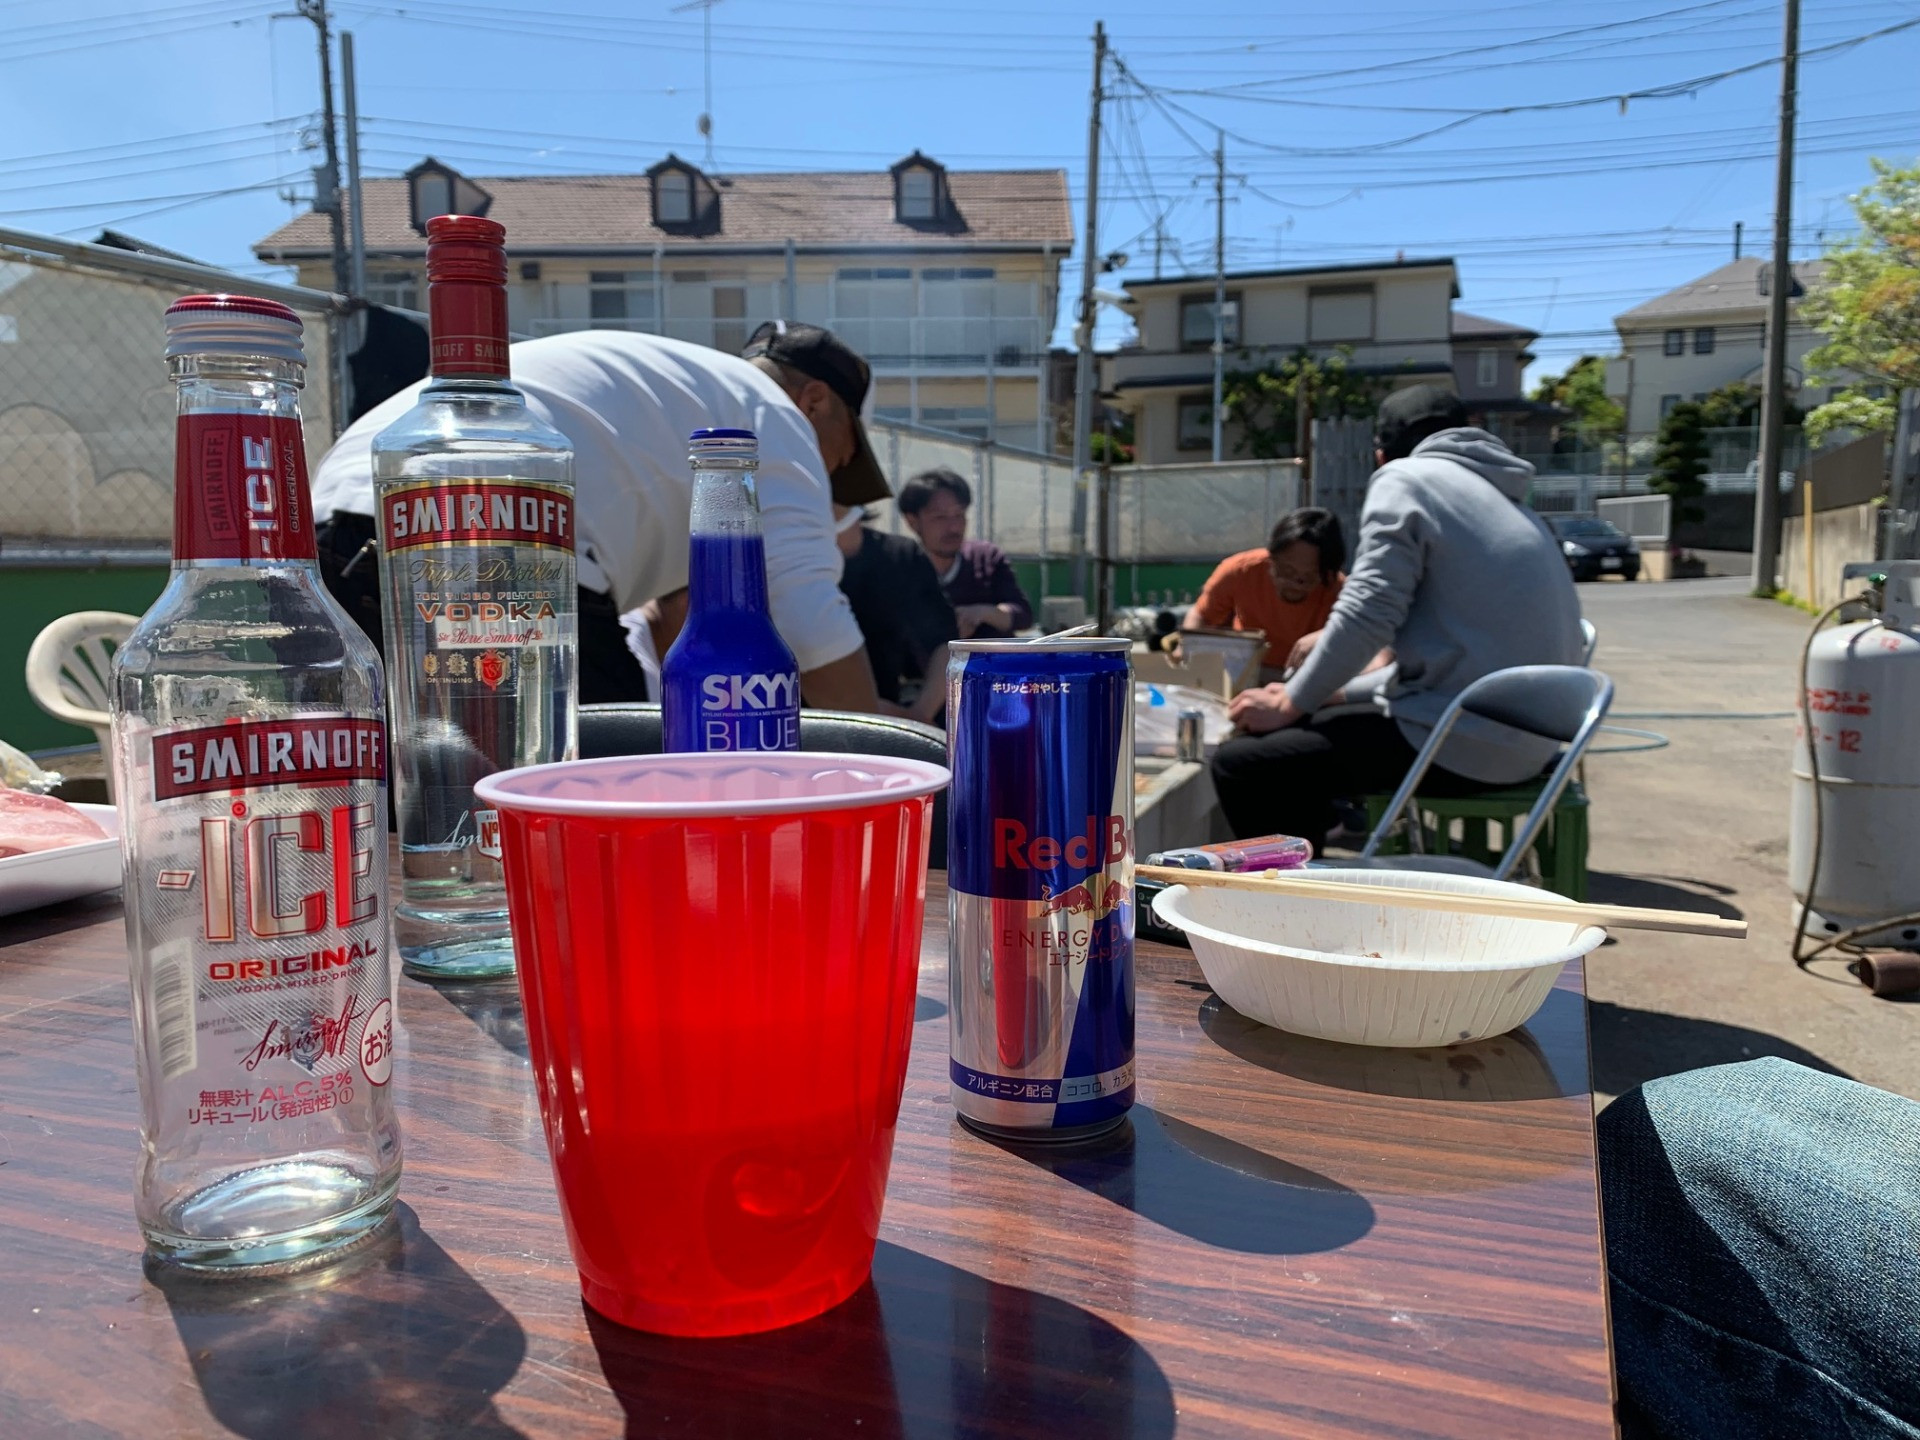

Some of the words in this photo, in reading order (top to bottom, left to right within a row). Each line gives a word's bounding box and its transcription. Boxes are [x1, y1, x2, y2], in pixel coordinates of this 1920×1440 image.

[283, 439, 301, 533] ORIGINAL
[392, 494, 568, 538] SMIRNOFF
[416, 600, 557, 624] VODKA
[702, 671, 797, 711] SKYY
[991, 682, 1072, 695] キリッと冷やして
[705, 716, 798, 752] BLUE
[171, 728, 379, 786] SMIRNOFF
[994, 815, 1097, 871] Red
[1002, 925, 1102, 949] ENERGY
[208, 940, 378, 981] ORIGINAL
[234, 982, 282, 994] VODKA
[287, 975, 328, 989] MIXED
[332, 965, 364, 981] DRINK
[199, 1087, 254, 1108] 無果汁
[967, 1072, 1054, 1099] アルギニン配合
